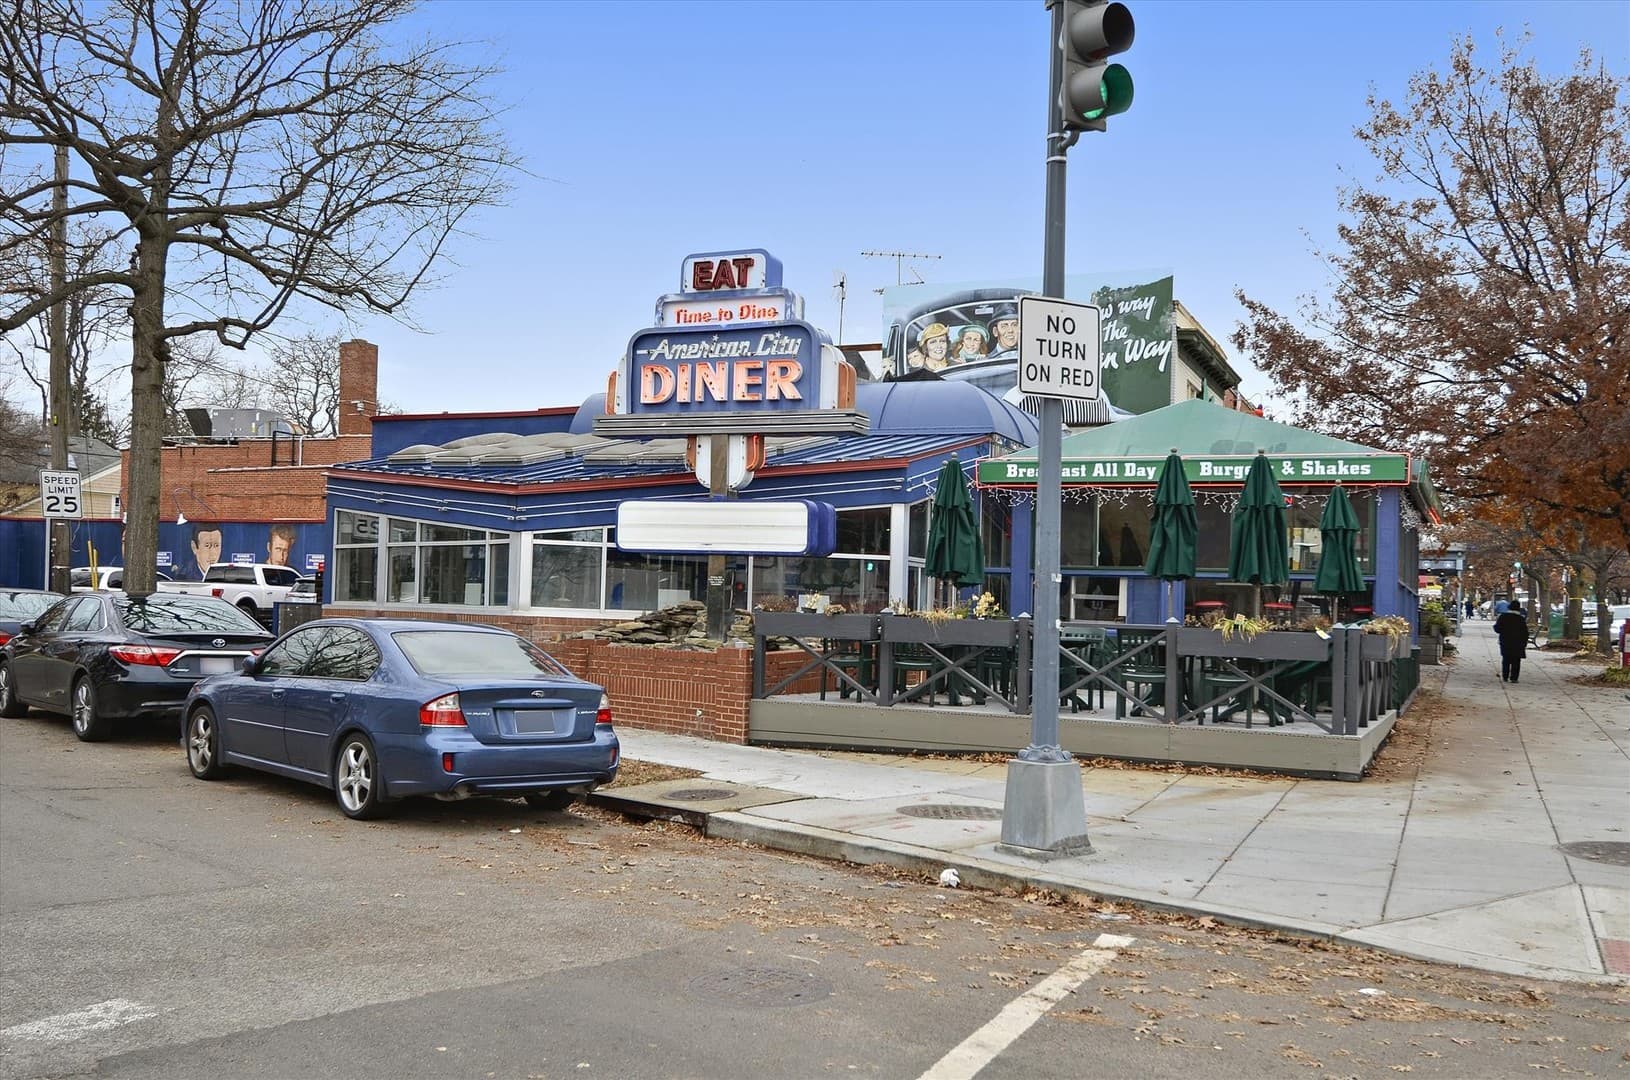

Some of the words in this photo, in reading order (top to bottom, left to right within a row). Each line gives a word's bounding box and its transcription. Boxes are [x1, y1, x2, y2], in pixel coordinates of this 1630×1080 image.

[692, 257, 754, 291] EAT
[675, 308, 712, 324] Time
[718, 308, 733, 321] to
[739, 305, 778, 320] Dine
[1118, 296, 1155, 320] way
[1047, 314, 1075, 335] NO
[1103, 320, 1128, 342] the
[640, 338, 751, 360] American
[754, 333, 801, 358] City
[1036, 338, 1086, 360] TURN
[1124, 339, 1172, 372] Way
[640, 359, 803, 404] DINER
[1026, 363, 1050, 382] ON
[1061, 367, 1094, 387] RED
[44, 476, 78, 485] SPEED
[1006, 463, 1086, 478] Breast
[1092, 463, 1118, 477] All
[1124, 462, 1156, 480] Day
[1281, 460, 1295, 475] &
[1302, 460, 1371, 476] Shakes
[48, 486, 74, 494] LIMIT
[46, 496, 78, 513] 25
